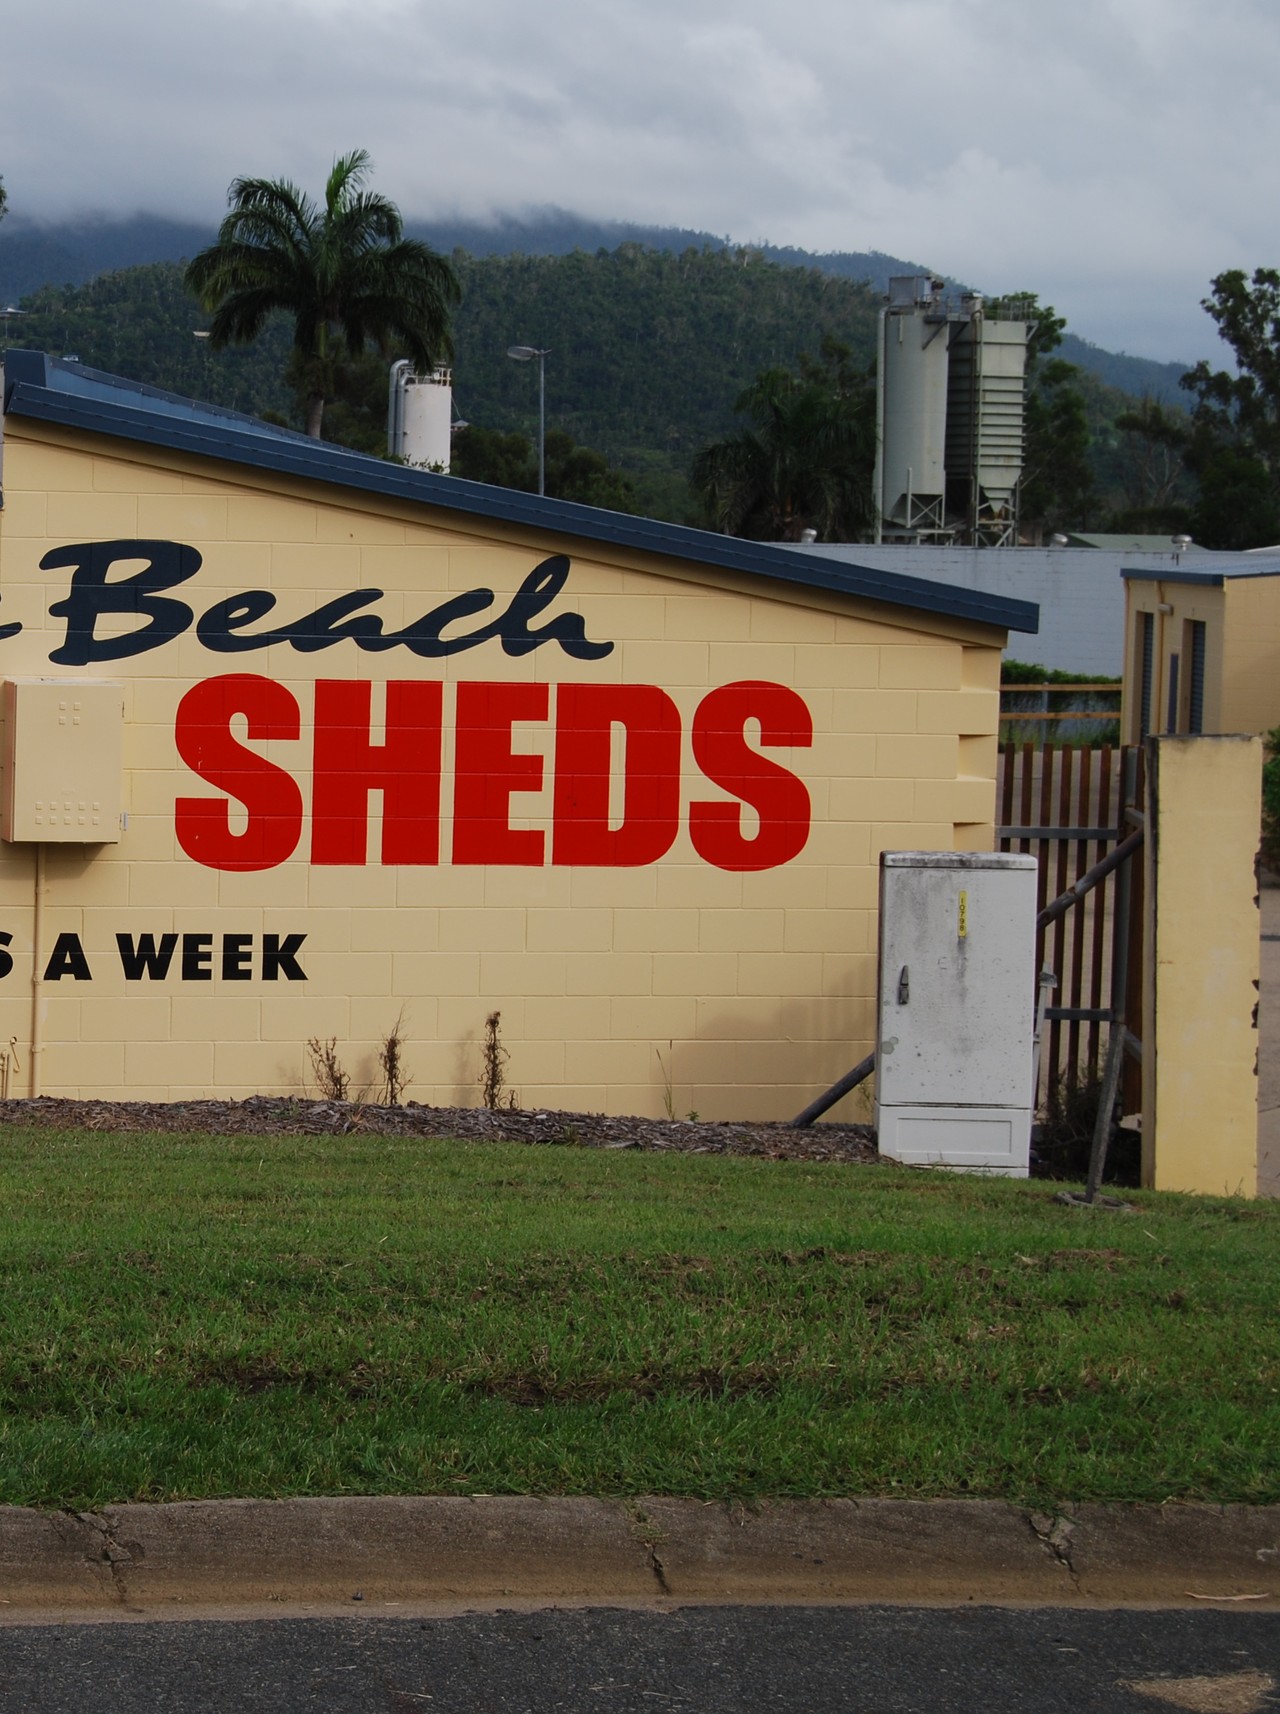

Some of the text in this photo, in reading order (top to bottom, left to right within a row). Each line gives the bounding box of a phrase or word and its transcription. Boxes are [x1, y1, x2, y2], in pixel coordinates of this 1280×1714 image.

[38, 539, 614, 666] Beach
[175, 674, 812, 872] SHEDS
[43, 932, 93, 981] A
[116, 932, 309, 981] WEEK
